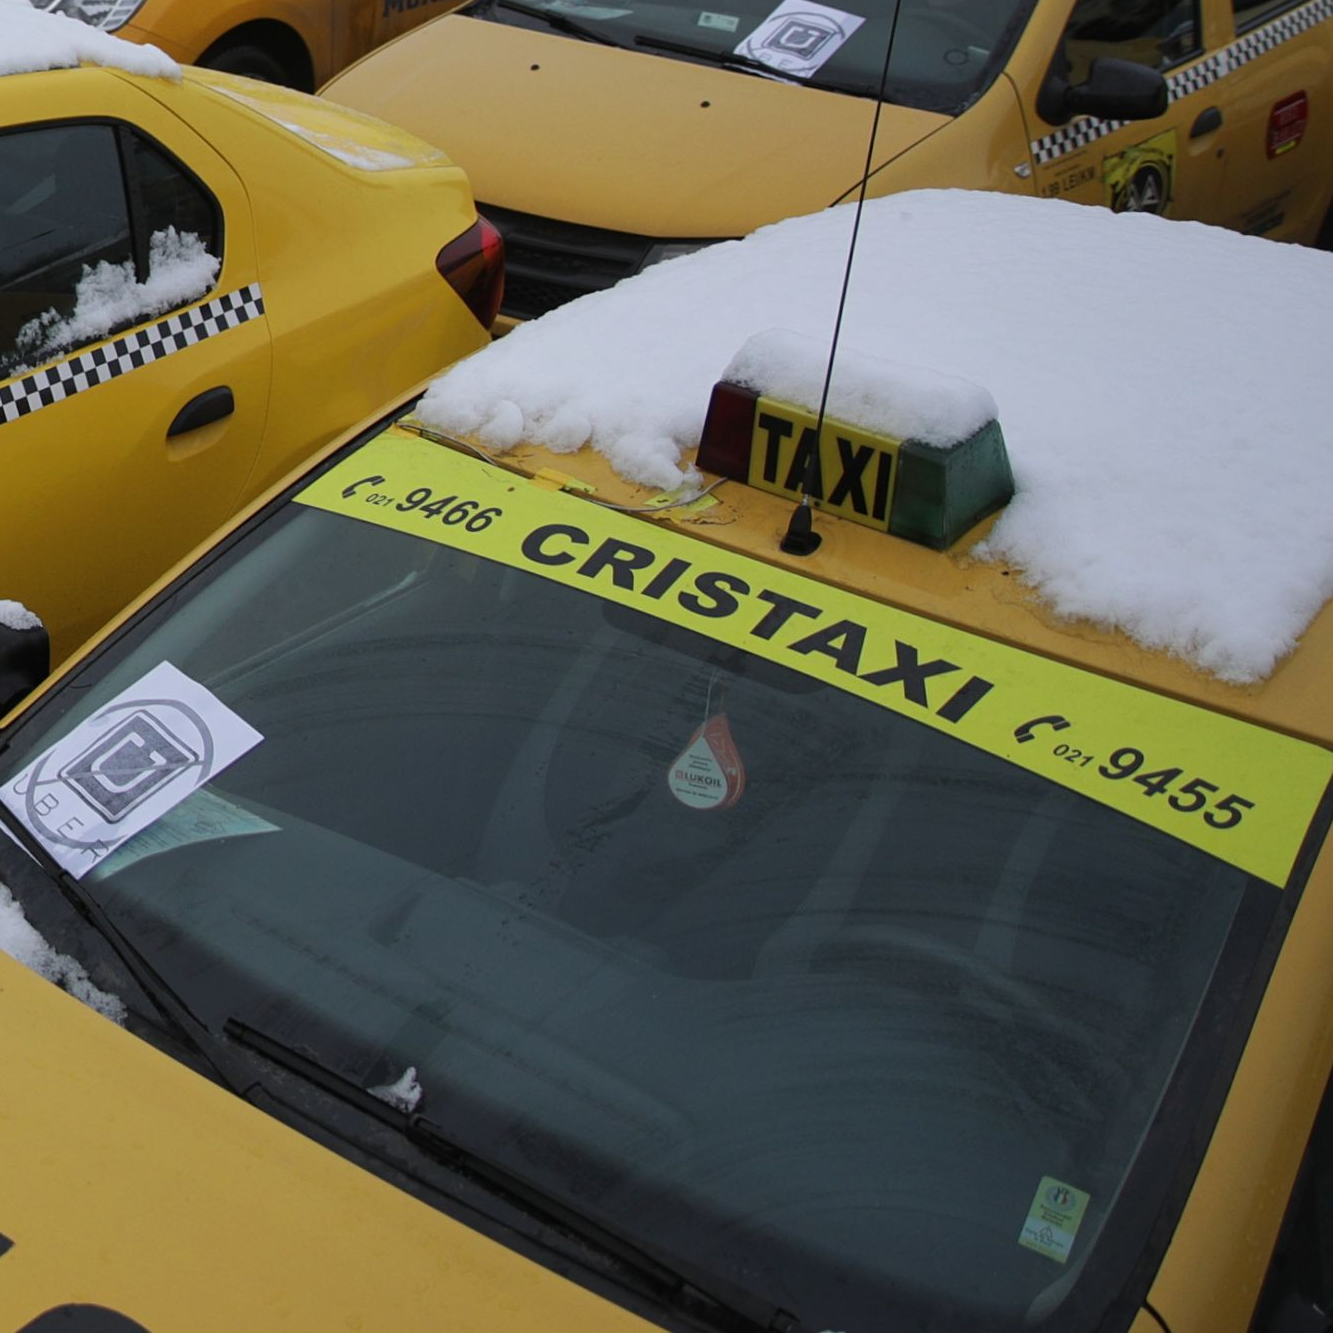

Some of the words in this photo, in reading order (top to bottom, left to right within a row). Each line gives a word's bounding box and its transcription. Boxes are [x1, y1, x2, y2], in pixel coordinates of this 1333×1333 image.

[759, 413, 893, 521] TAXI
[365, 493, 396, 507] 021
[395, 488, 503, 532] 9466
[521, 523, 995, 724] CRISTAXI
[1053, 744, 1094, 767] 021
[1098, 747, 1256, 829] 9455
[12, 772, 110, 864] UBER
[685, 771, 722, 788] LUKOIL
